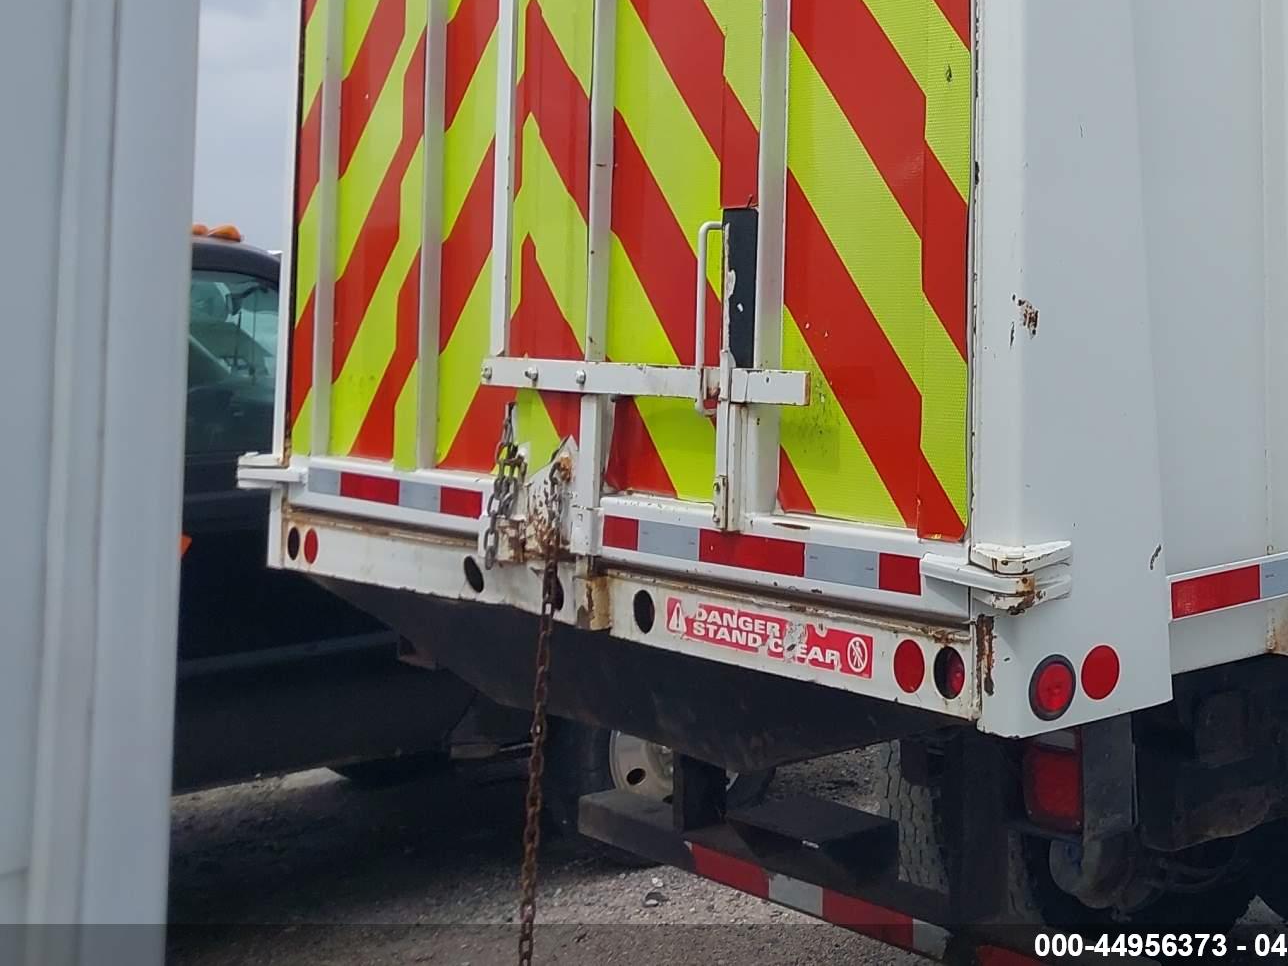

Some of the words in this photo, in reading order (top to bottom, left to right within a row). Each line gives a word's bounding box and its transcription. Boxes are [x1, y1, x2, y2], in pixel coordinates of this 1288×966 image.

[694, 607, 781, 638] DANGER
[692, 621, 763, 648] STAND
[767, 637, 841, 666] CEAR
